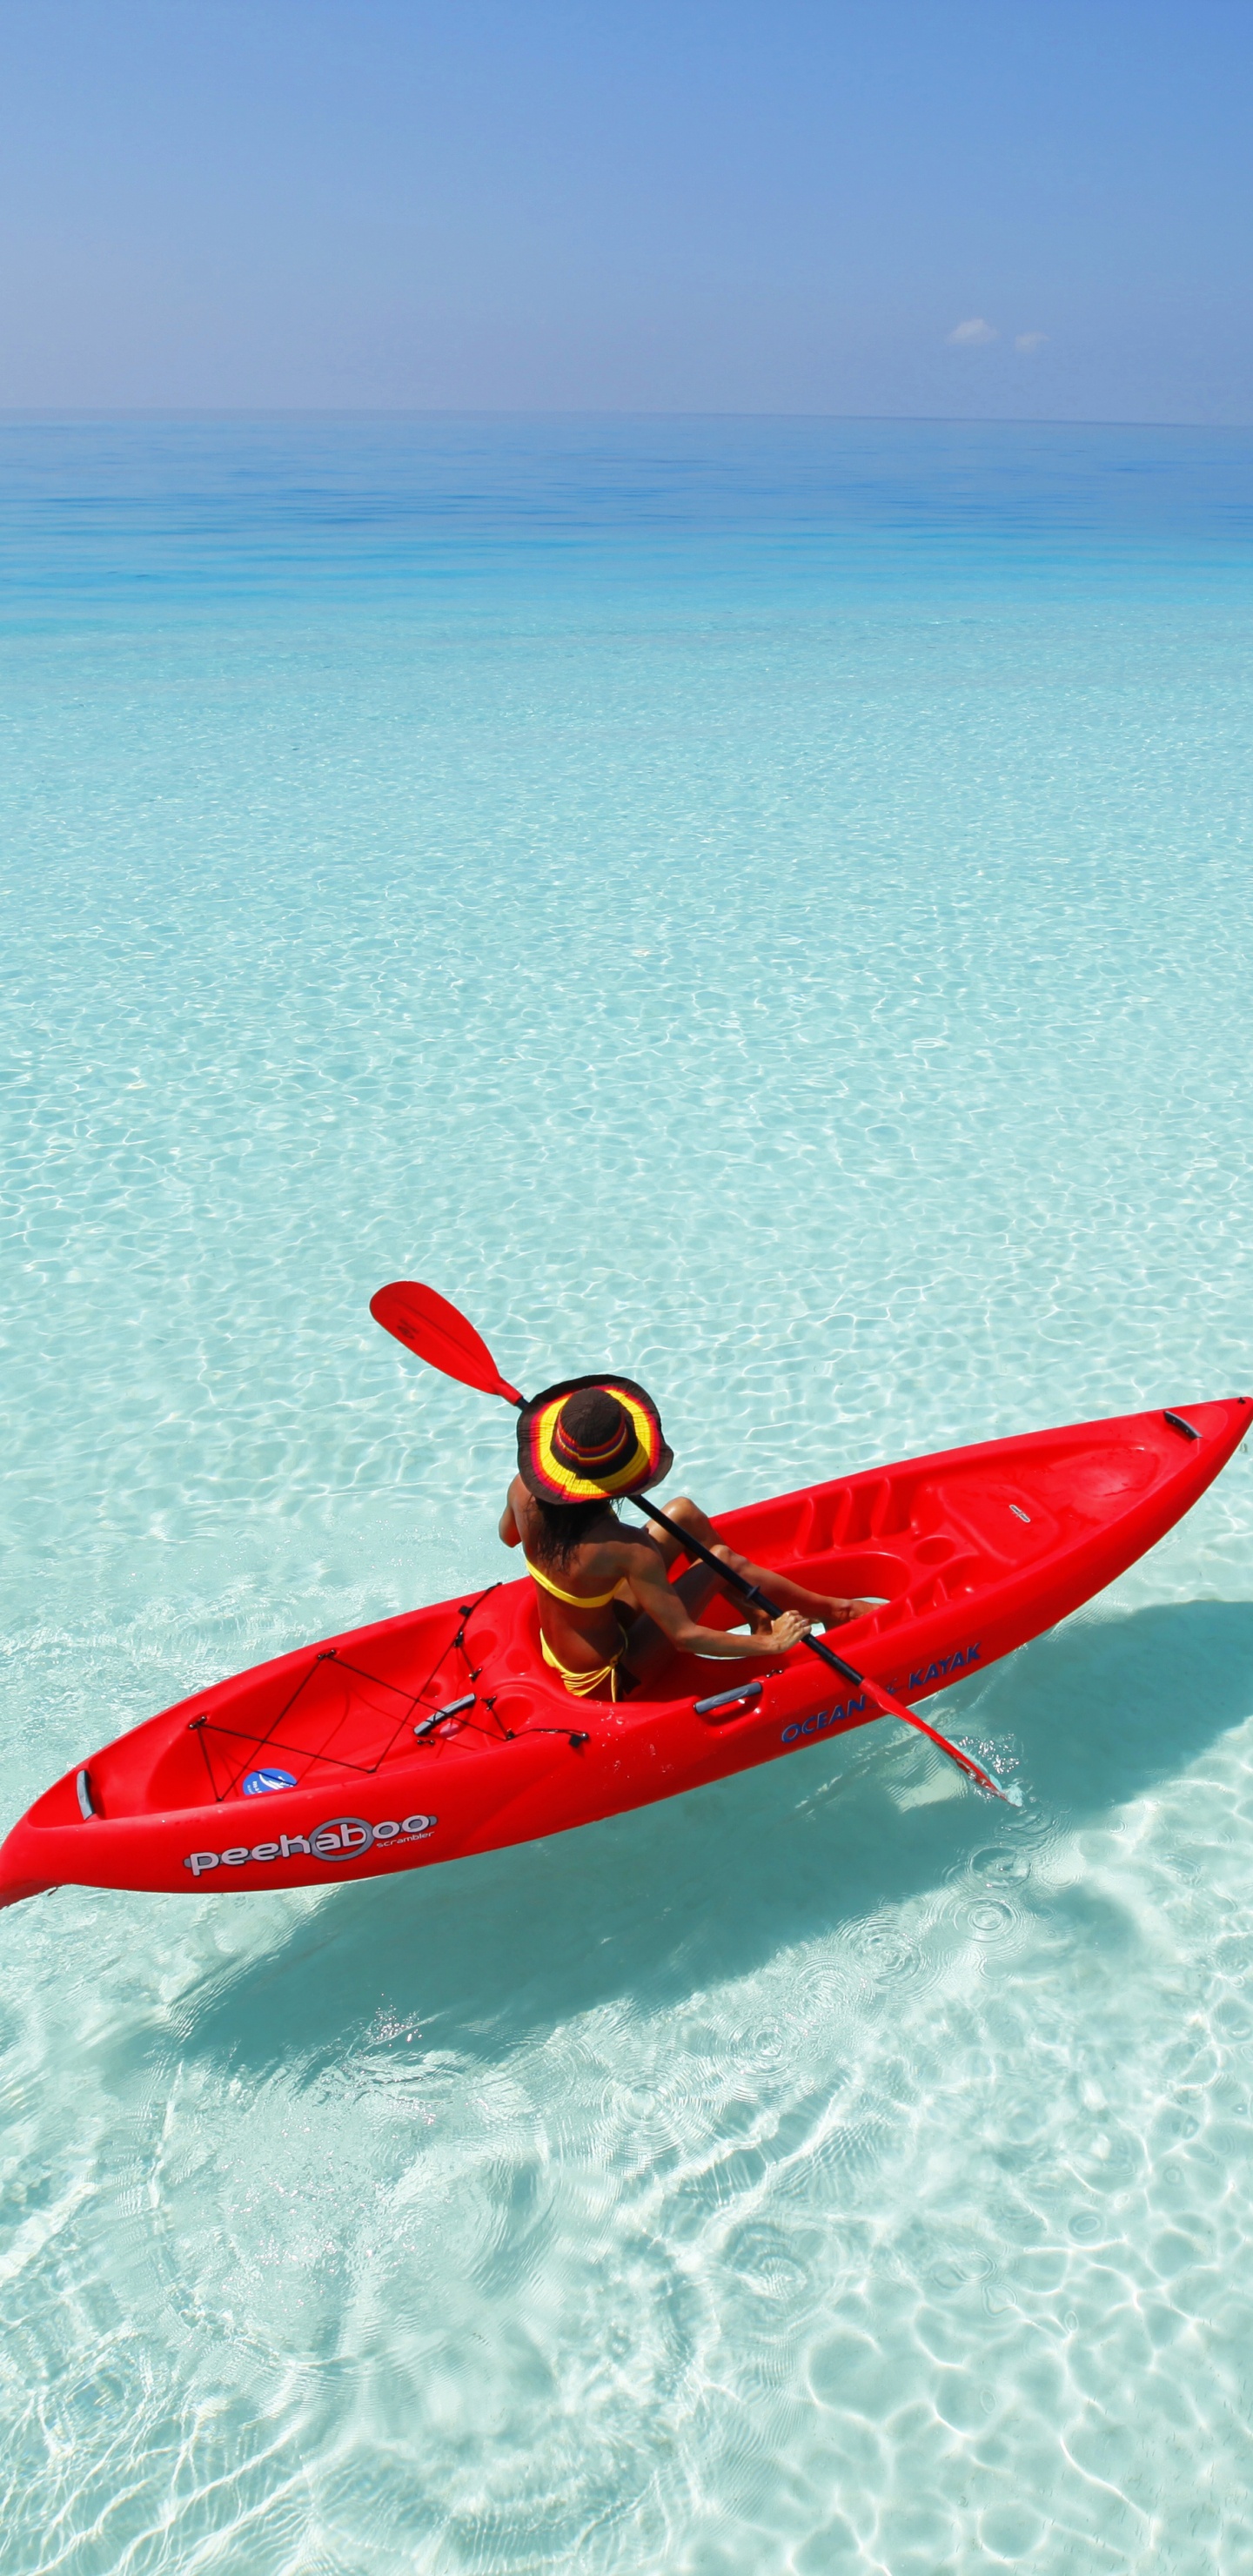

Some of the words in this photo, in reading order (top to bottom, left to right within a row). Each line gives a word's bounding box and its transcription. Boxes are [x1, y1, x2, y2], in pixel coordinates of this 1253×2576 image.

[781, 1694, 866, 1743] OCEAN
[908, 1642, 982, 1689] KAYAK
[189, 1815, 430, 1876] peekaboo
[376, 1831, 435, 1848] scrambler
